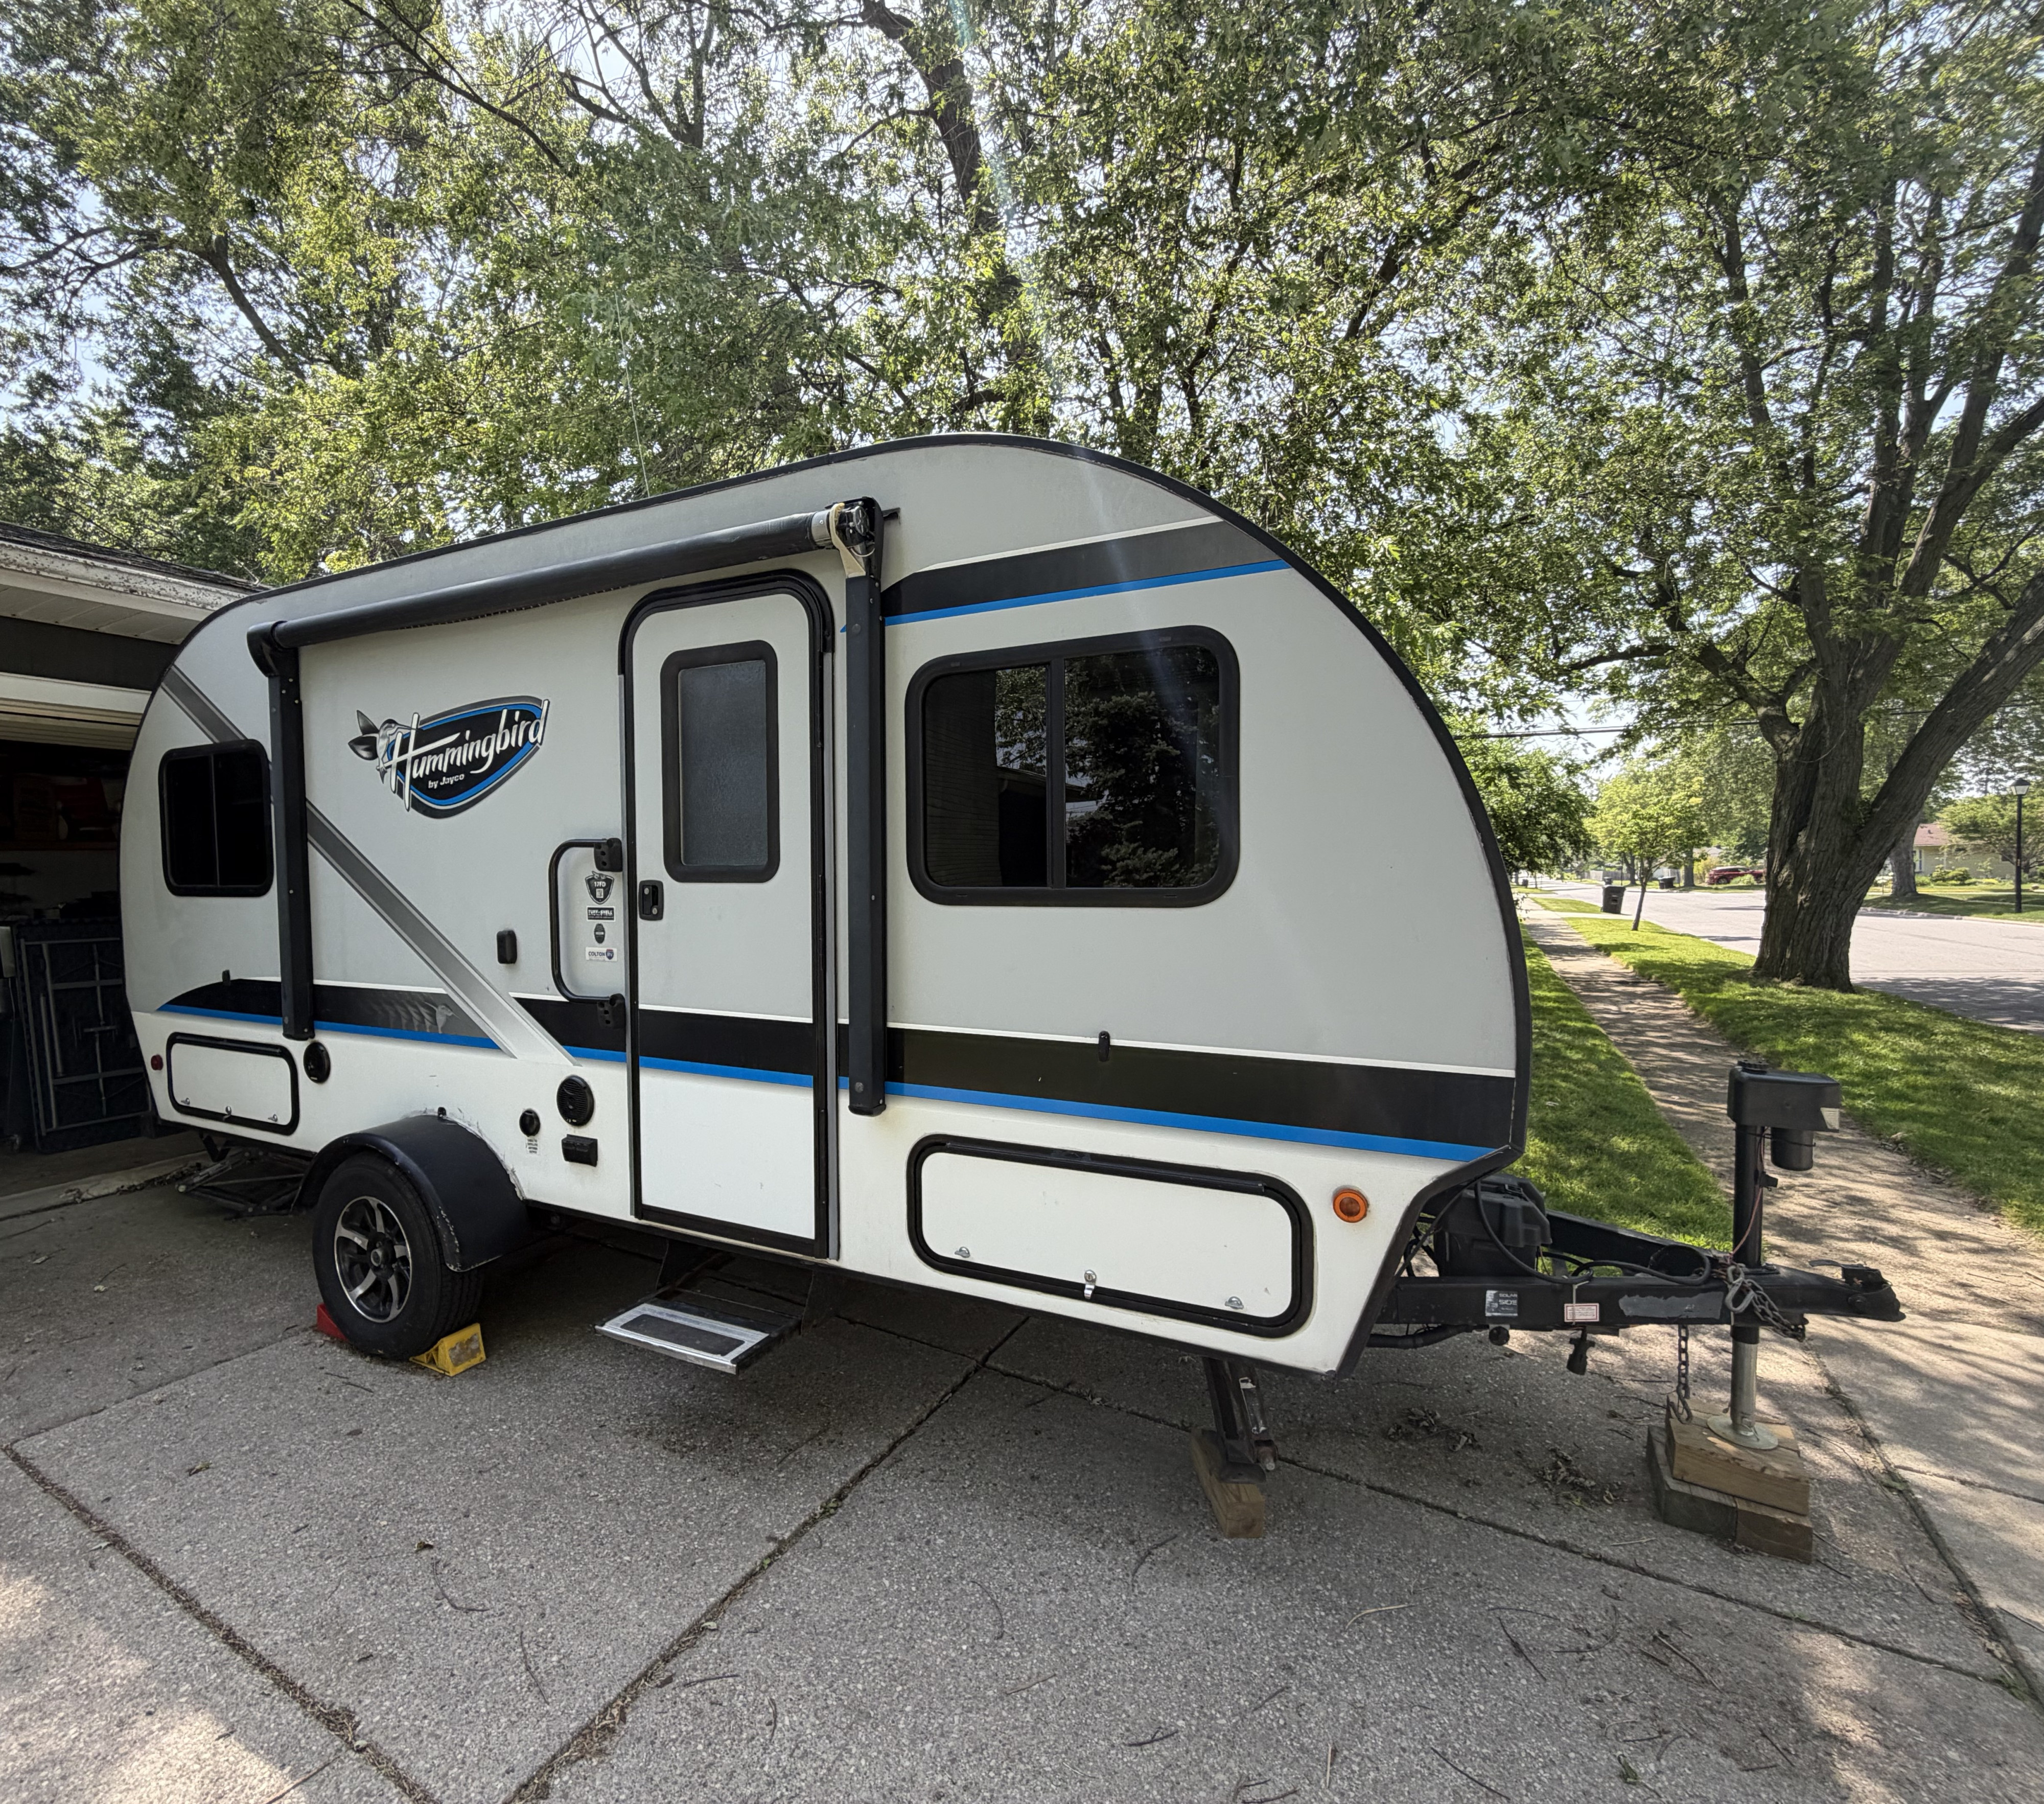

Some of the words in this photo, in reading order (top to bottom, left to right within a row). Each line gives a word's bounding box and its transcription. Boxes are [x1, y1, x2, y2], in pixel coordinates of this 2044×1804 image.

[383, 699, 550, 812] Hummingbird
[428, 780, 438, 789] by
[440, 774, 464, 785] Jayco
